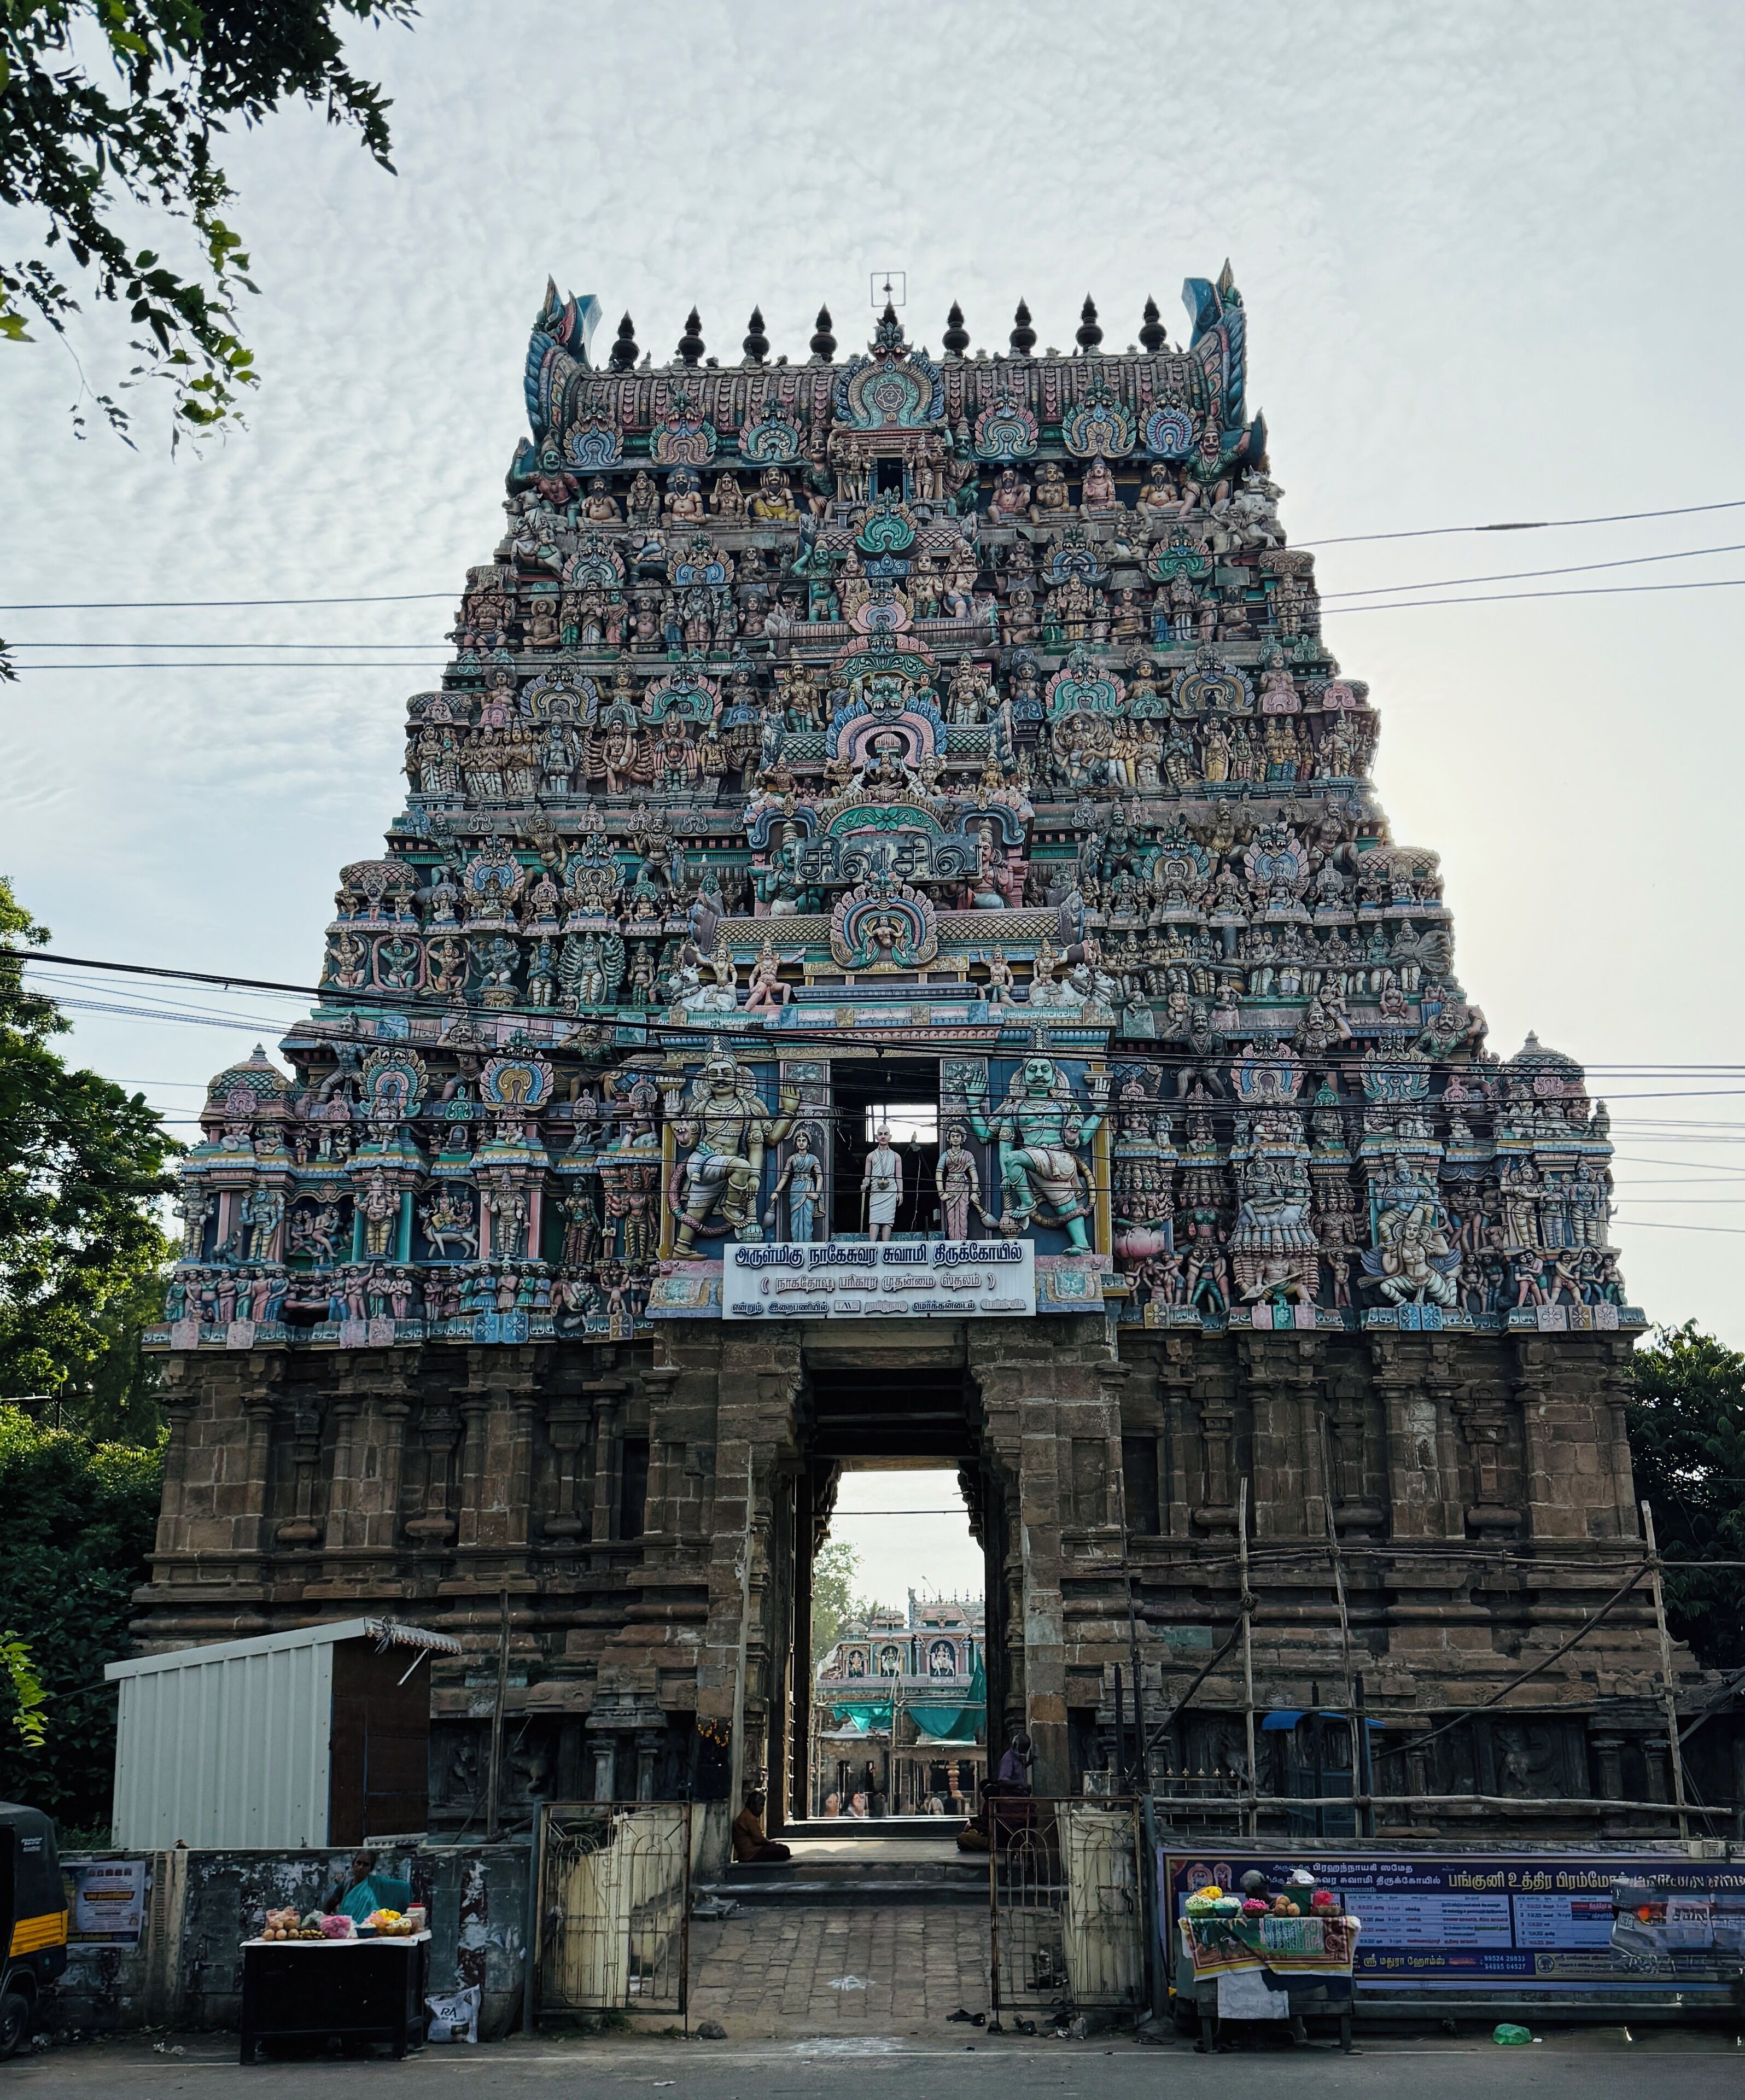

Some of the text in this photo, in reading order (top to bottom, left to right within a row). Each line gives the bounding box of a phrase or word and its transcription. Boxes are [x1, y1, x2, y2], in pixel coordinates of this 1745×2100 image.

[735, 1241, 1024, 1271] அருள்மிகு நாகேசுவர சுவாமி திருக்கோயில்
[775, 1275, 835, 1294] நாகதோஷ
[839, 1274, 877, 1291] பரிகார
[882, 1273, 936, 1292] முதன்மை
[941, 1273, 982, 1291] ஸ்தலம்
[732, 1302, 763, 1315] என்றும்
[768, 1302, 829, 1315] இறைபணியில்
[913, 1300, 976, 1311] மெர்க்கன்டைல்
[1380, 1864, 1413, 1874] ஸமேத
[1340, 1875, 1373, 1884] சுவாமி
[1376, 1875, 1441, 1886] திருக்கோயில்
[1449, 1870, 1505, 1890] பங்குனி
[1508, 1870, 1553, 1892] உத்திர
[1380, 1957, 1404, 1969] மதுரா
[1407, 1955, 1445, 1968] ஹோம்ஸ்
